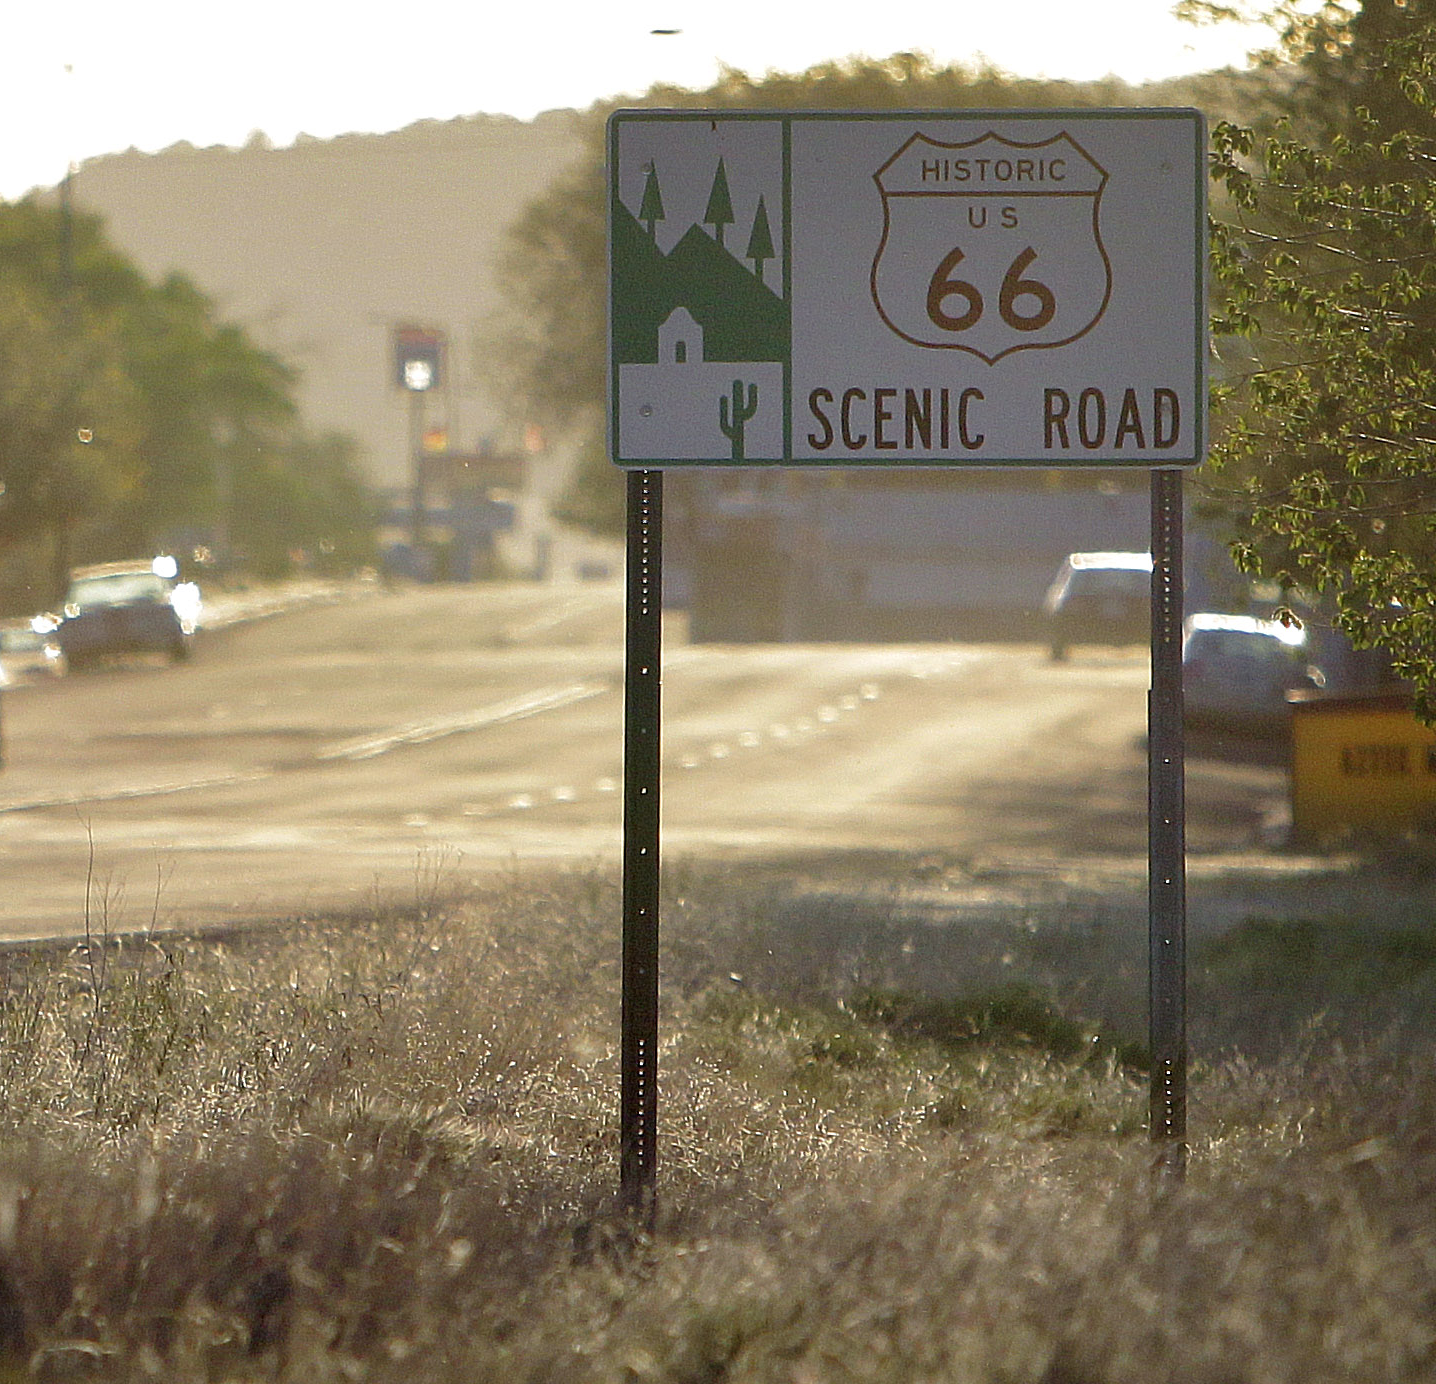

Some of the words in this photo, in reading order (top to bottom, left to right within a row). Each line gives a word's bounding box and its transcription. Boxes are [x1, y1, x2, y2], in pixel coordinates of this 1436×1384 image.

[921, 158, 1066, 182] HISTORIC
[926, 245, 1056, 332] 66
[807, 387, 985, 451] SCENIC
[1043, 387, 1181, 451] ROAD
